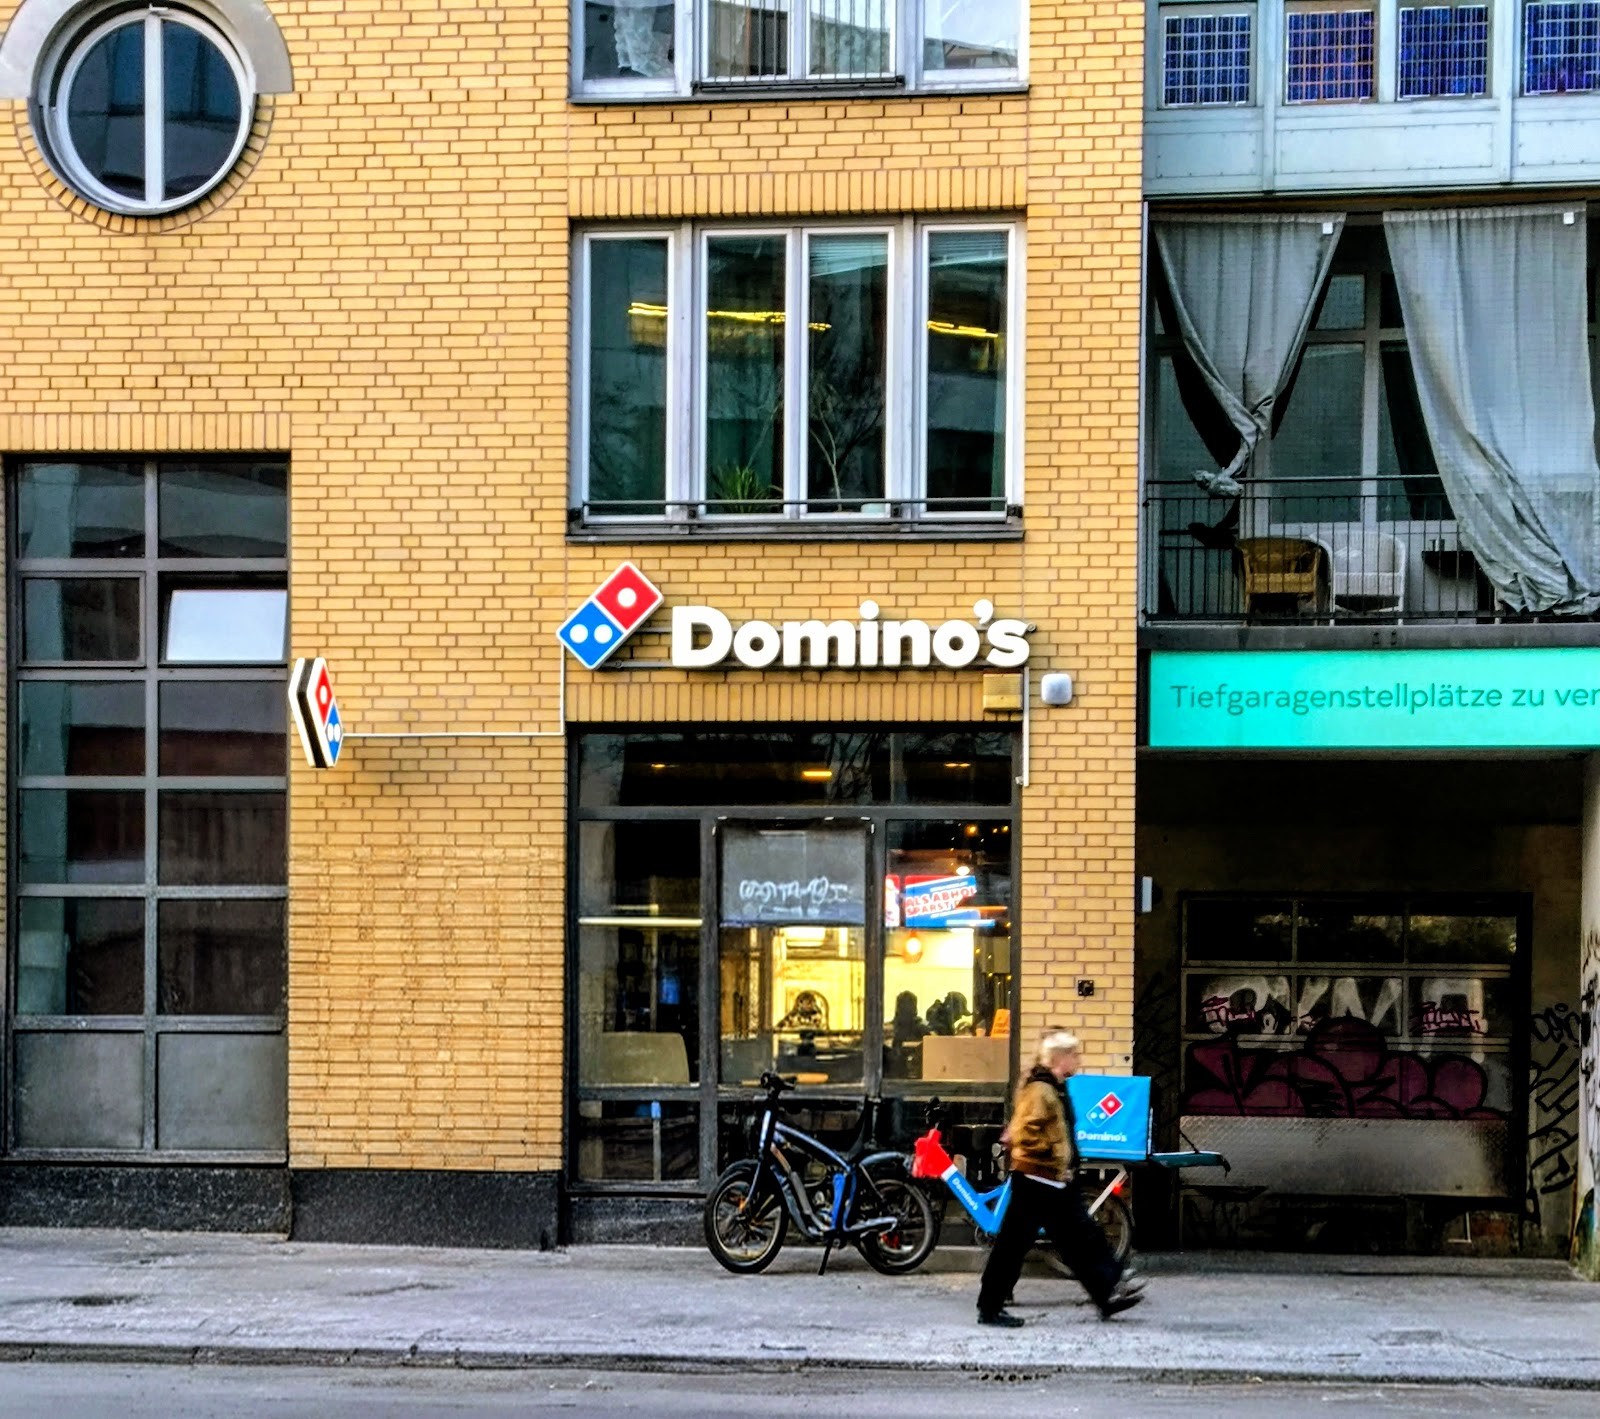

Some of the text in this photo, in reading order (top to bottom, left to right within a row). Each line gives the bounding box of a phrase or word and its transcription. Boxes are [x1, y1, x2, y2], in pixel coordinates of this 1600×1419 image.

[672, 599, 1031, 668] Domino's
[1169, 683, 1503, 715] Tiefgaragenstellplätze
[1512, 688, 1545, 706] zu
[1077, 1129, 1128, 1143] Domino's
[951, 1177, 979, 1211] Domino's
